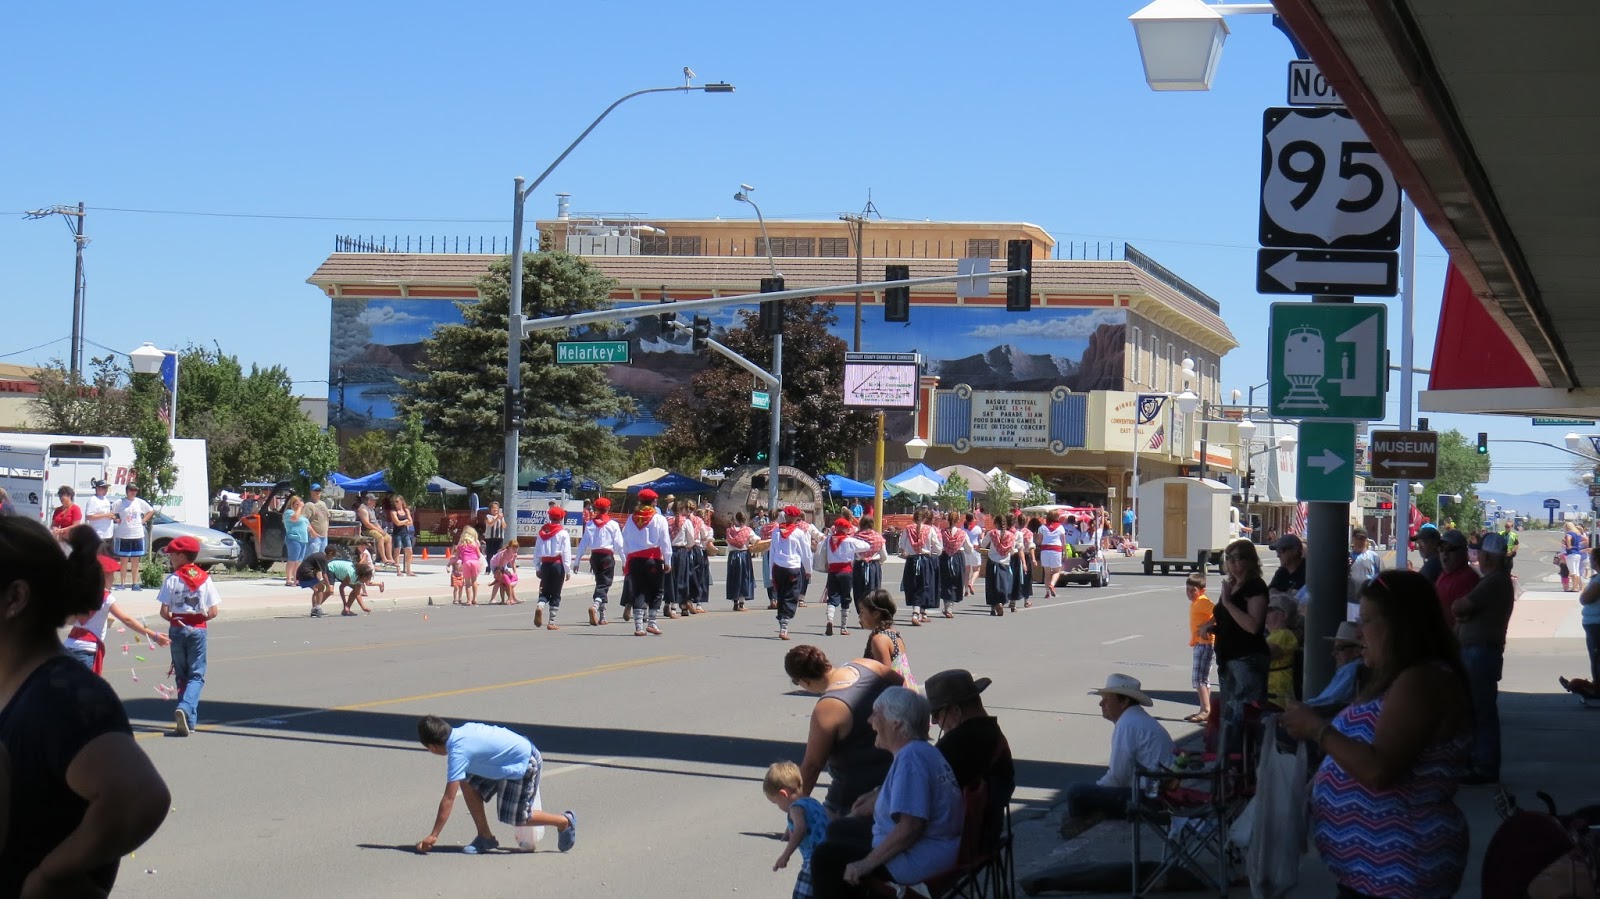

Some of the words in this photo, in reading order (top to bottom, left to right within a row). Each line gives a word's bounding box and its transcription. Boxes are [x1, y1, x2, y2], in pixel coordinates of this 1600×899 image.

[1277, 139, 1384, 213] 95
[559, 345, 614, 361] Melarkey
[617, 344, 625, 353] St
[1374, 441, 1435, 454] MUSEUM
